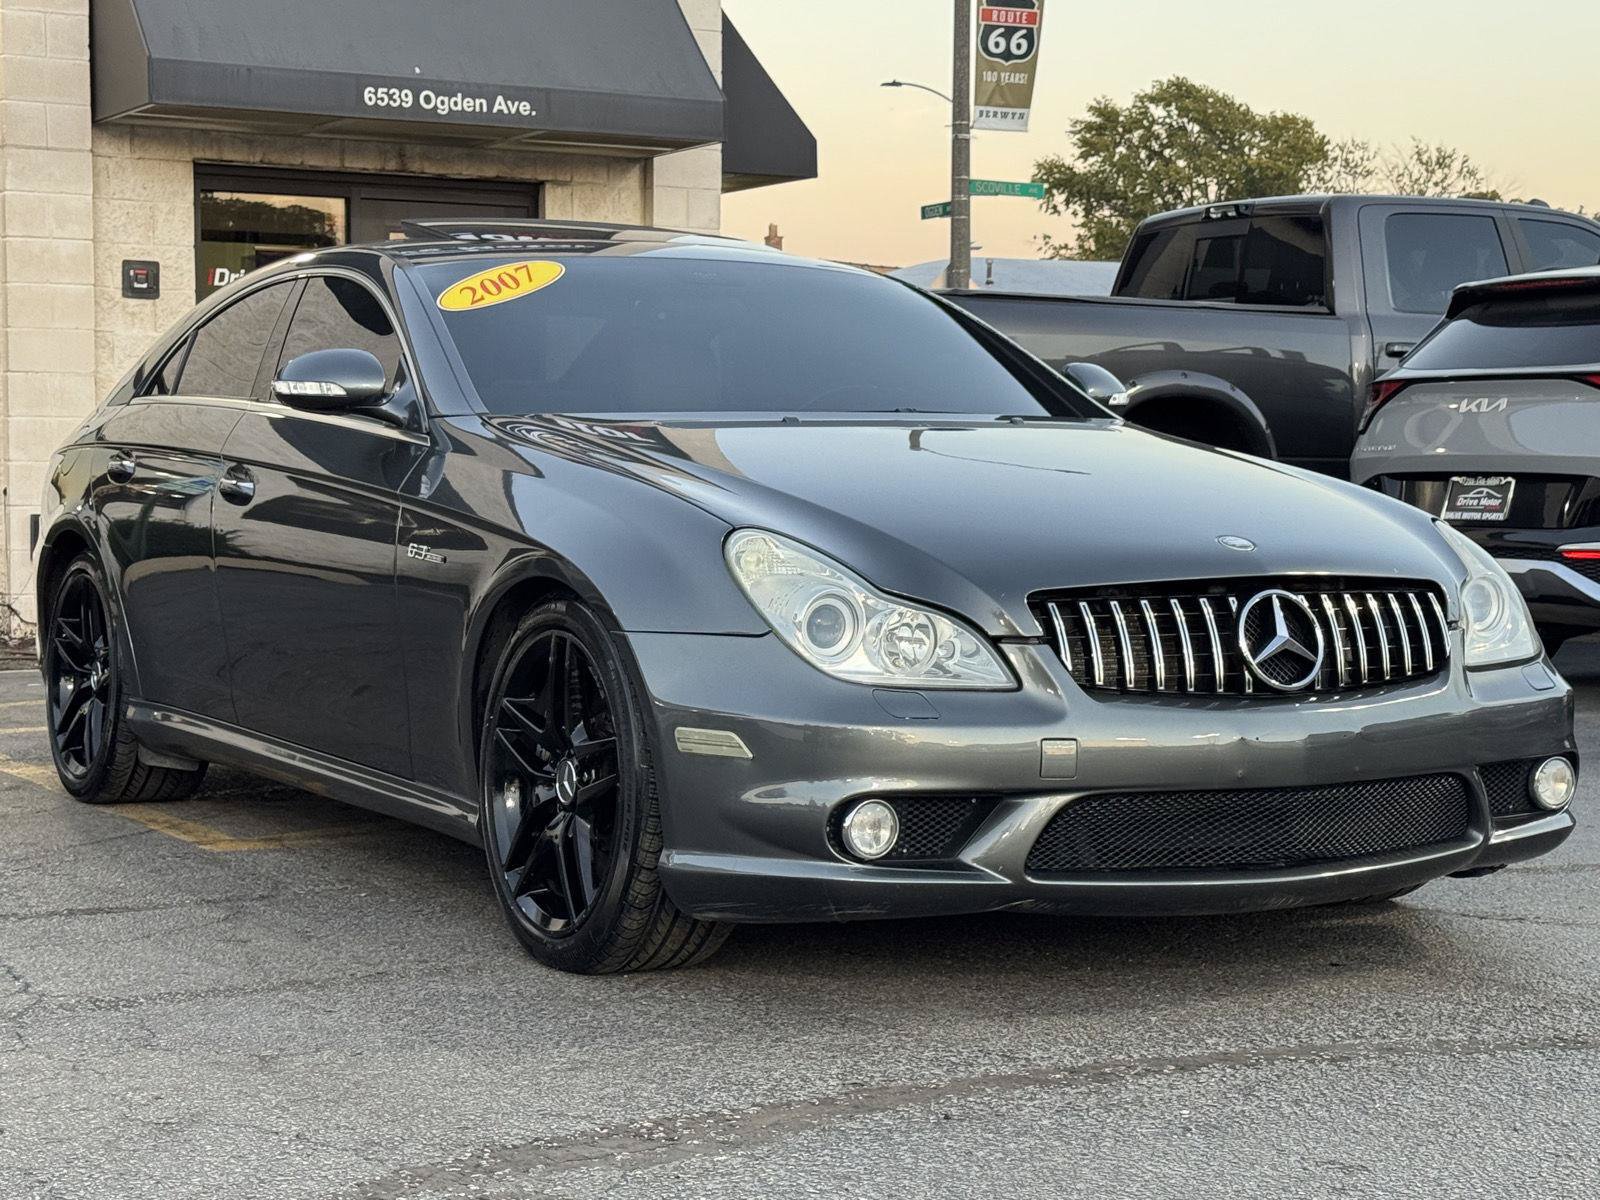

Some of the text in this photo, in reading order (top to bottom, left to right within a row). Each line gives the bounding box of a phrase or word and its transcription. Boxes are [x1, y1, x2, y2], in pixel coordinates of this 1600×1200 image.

[992, 10, 1028, 24] ROUTE
[987, 27, 1028, 56] 66
[982, 71, 998, 82] 100
[363, 86, 537, 116] 6539 Ogden Ave.
[978, 109, 1026, 120] BERWYN
[976, 182, 1021, 194] SCOVILLE
[459, 264, 533, 306] 2007
[1456, 497, 1502, 506] Drive Motor
[407, 543, 427, 560] 63
